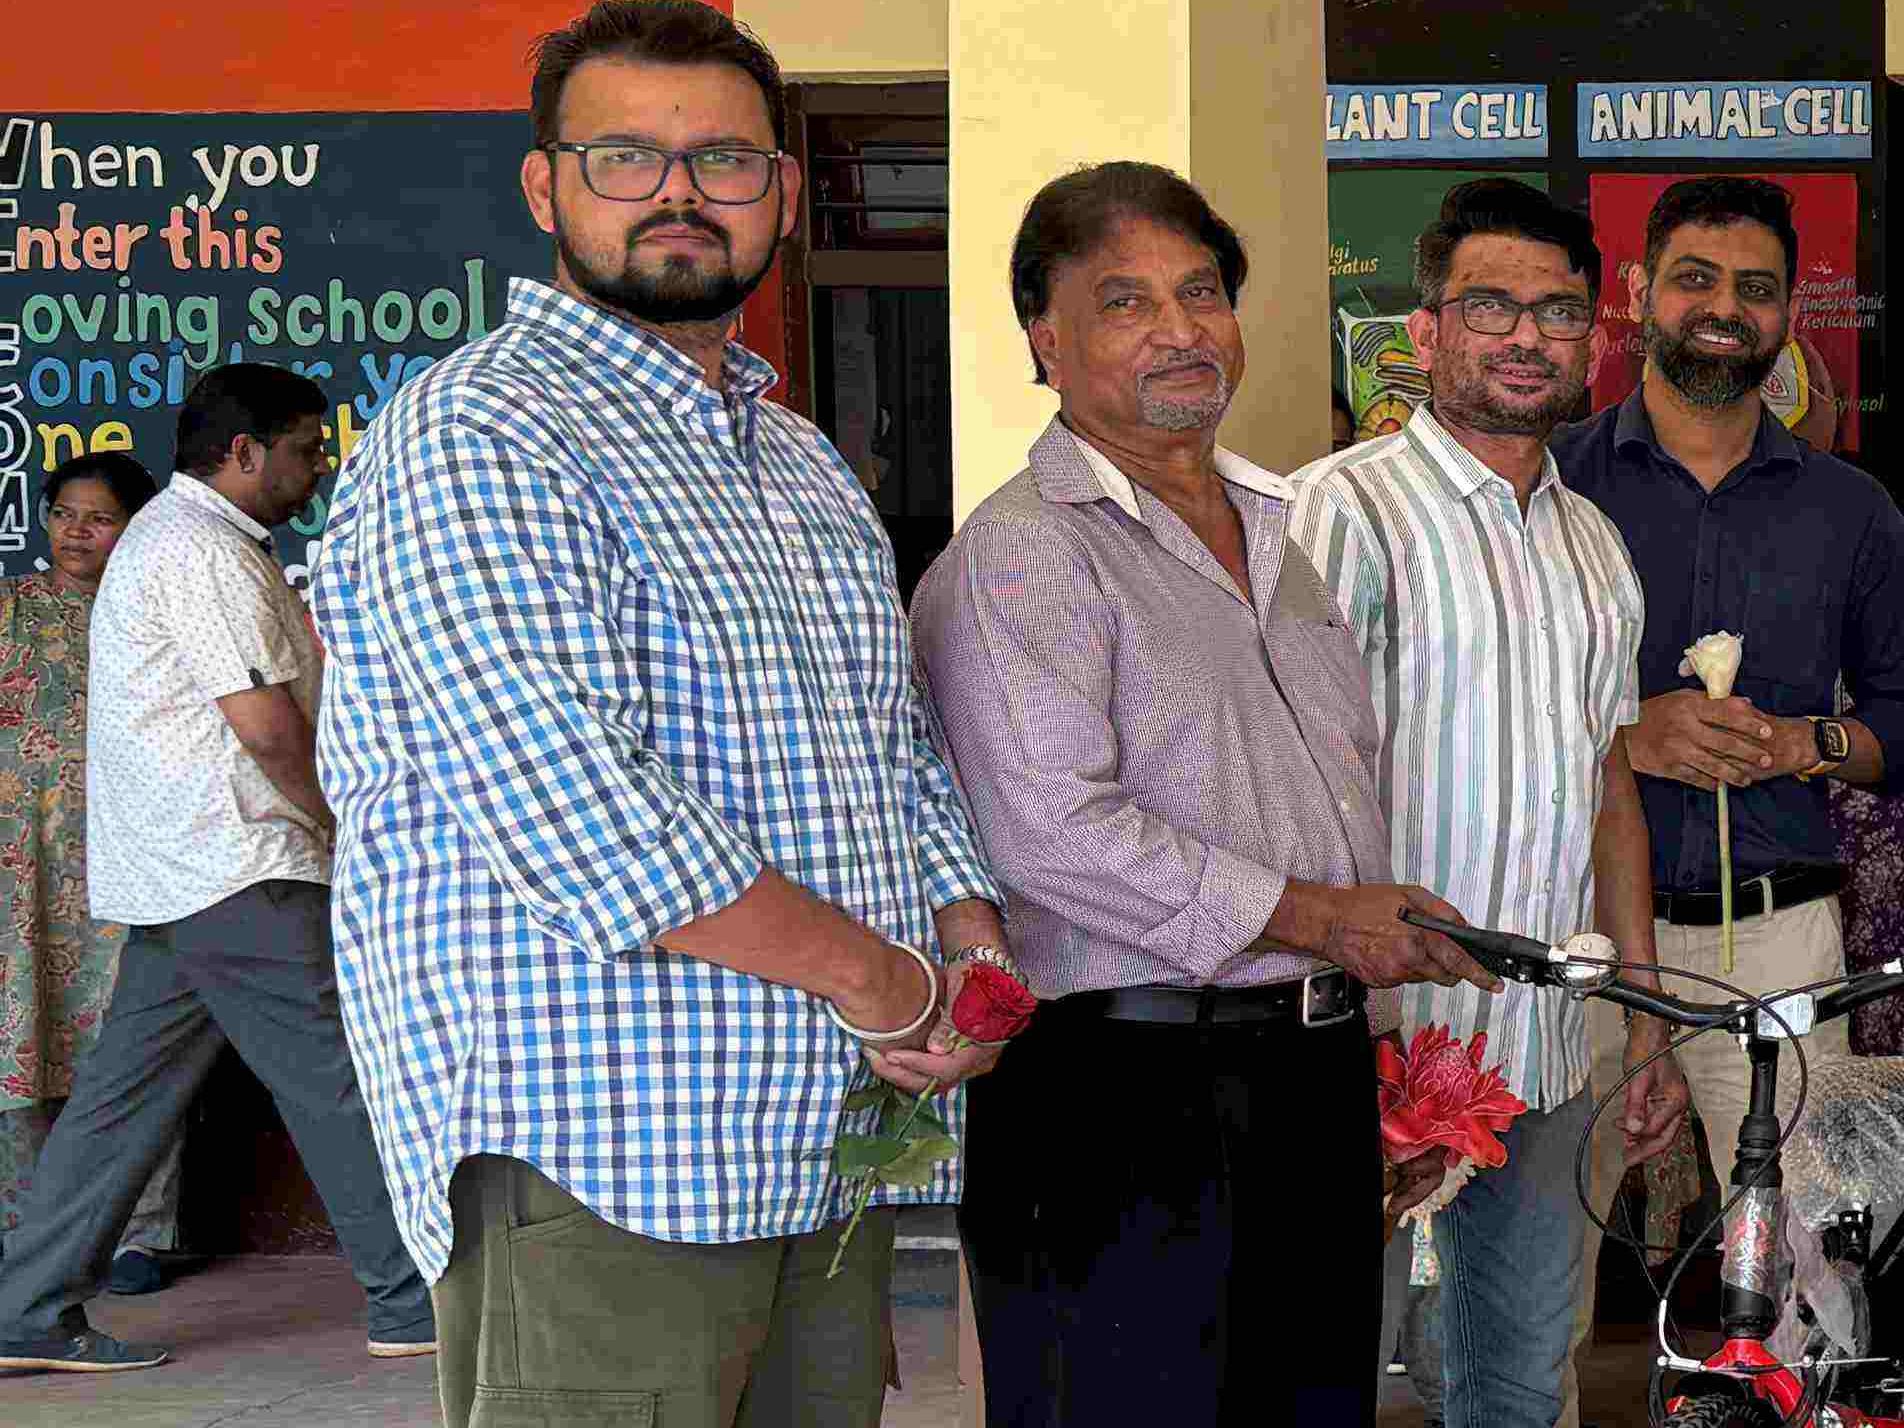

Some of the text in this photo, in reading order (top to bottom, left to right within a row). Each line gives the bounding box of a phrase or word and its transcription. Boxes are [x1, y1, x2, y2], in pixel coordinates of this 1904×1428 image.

[1327, 90, 1544, 141] LANT CELL
[1590, 85, 1871, 142] ANIMAL CELL
[184, 142, 321, 213] you
[0, 198, 283, 272] nter this
[0, 257, 486, 370] oving school
